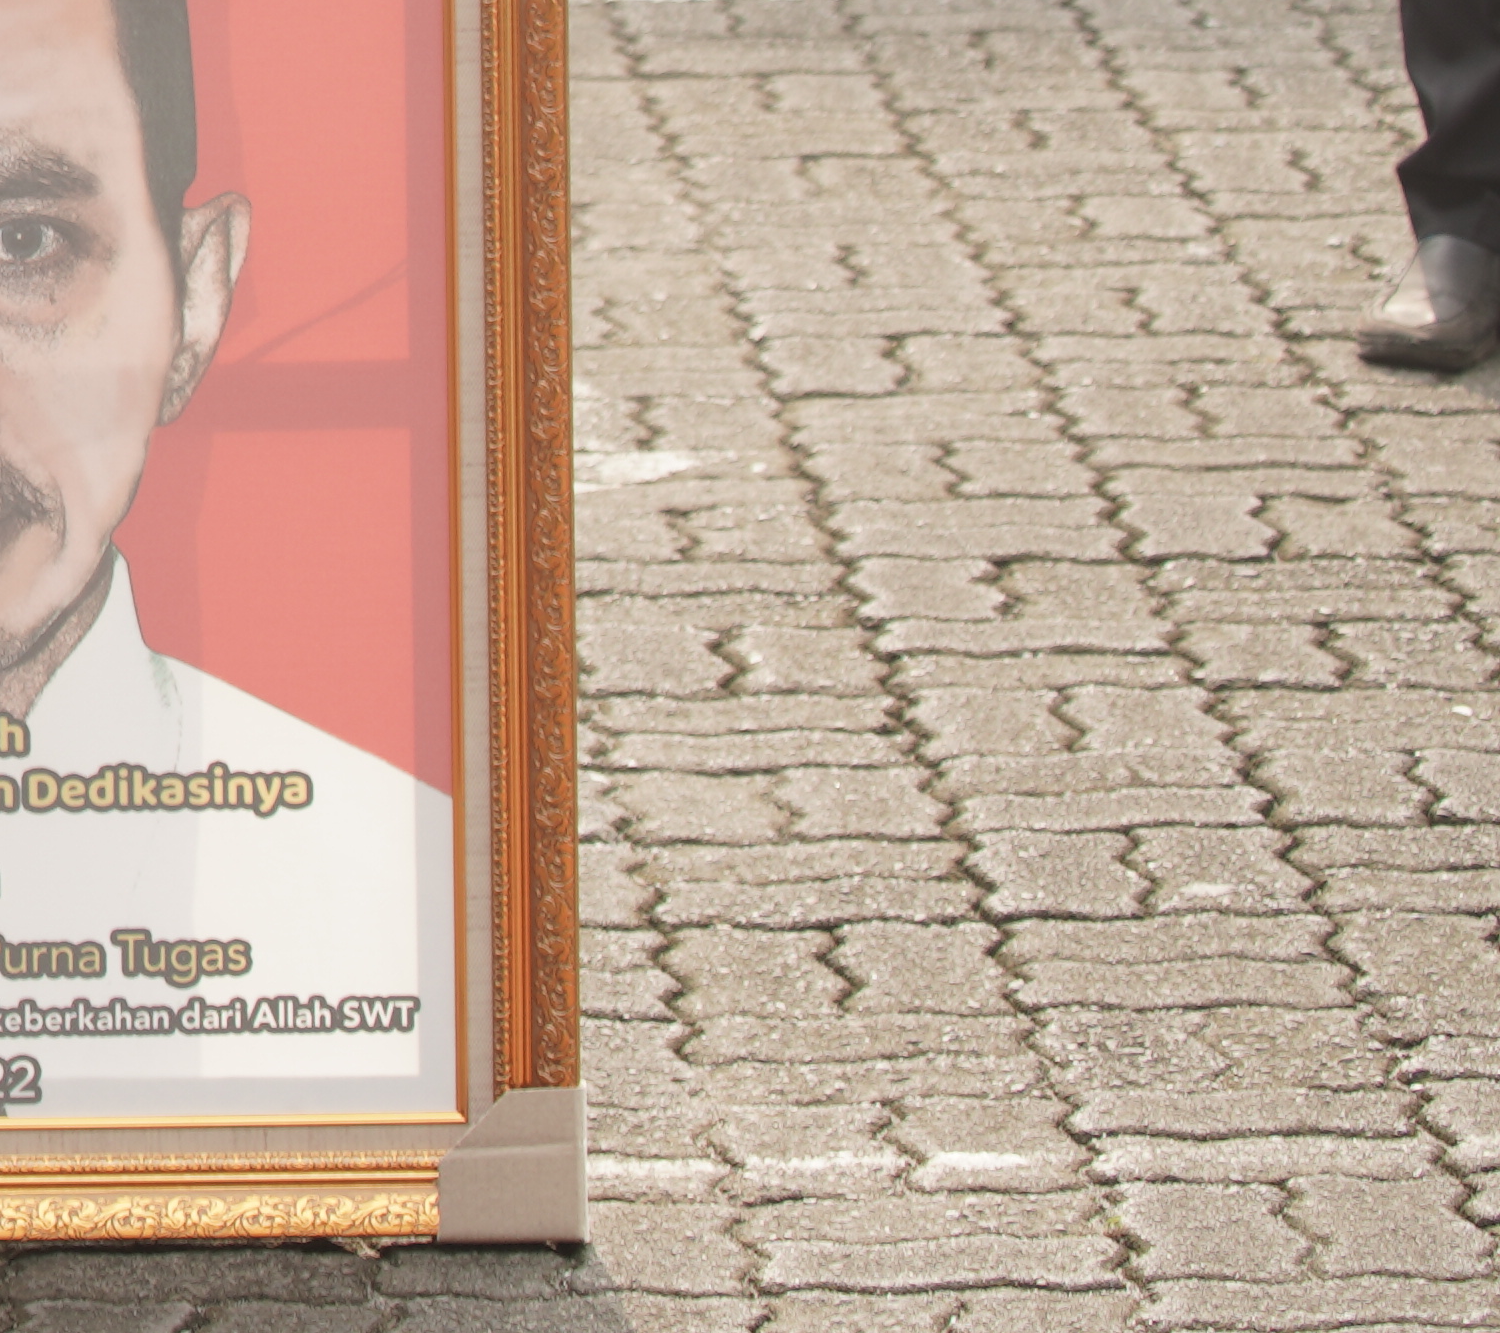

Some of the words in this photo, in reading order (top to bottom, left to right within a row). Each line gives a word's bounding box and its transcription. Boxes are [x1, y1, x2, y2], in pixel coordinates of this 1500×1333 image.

[26, 766, 311, 815] Dedikasinya
[115, 932, 249, 985] Tugas
[180, 999, 243, 1032] dari
[251, 998, 332, 1030] Allah
[342, 997, 417, 1030] SWT
